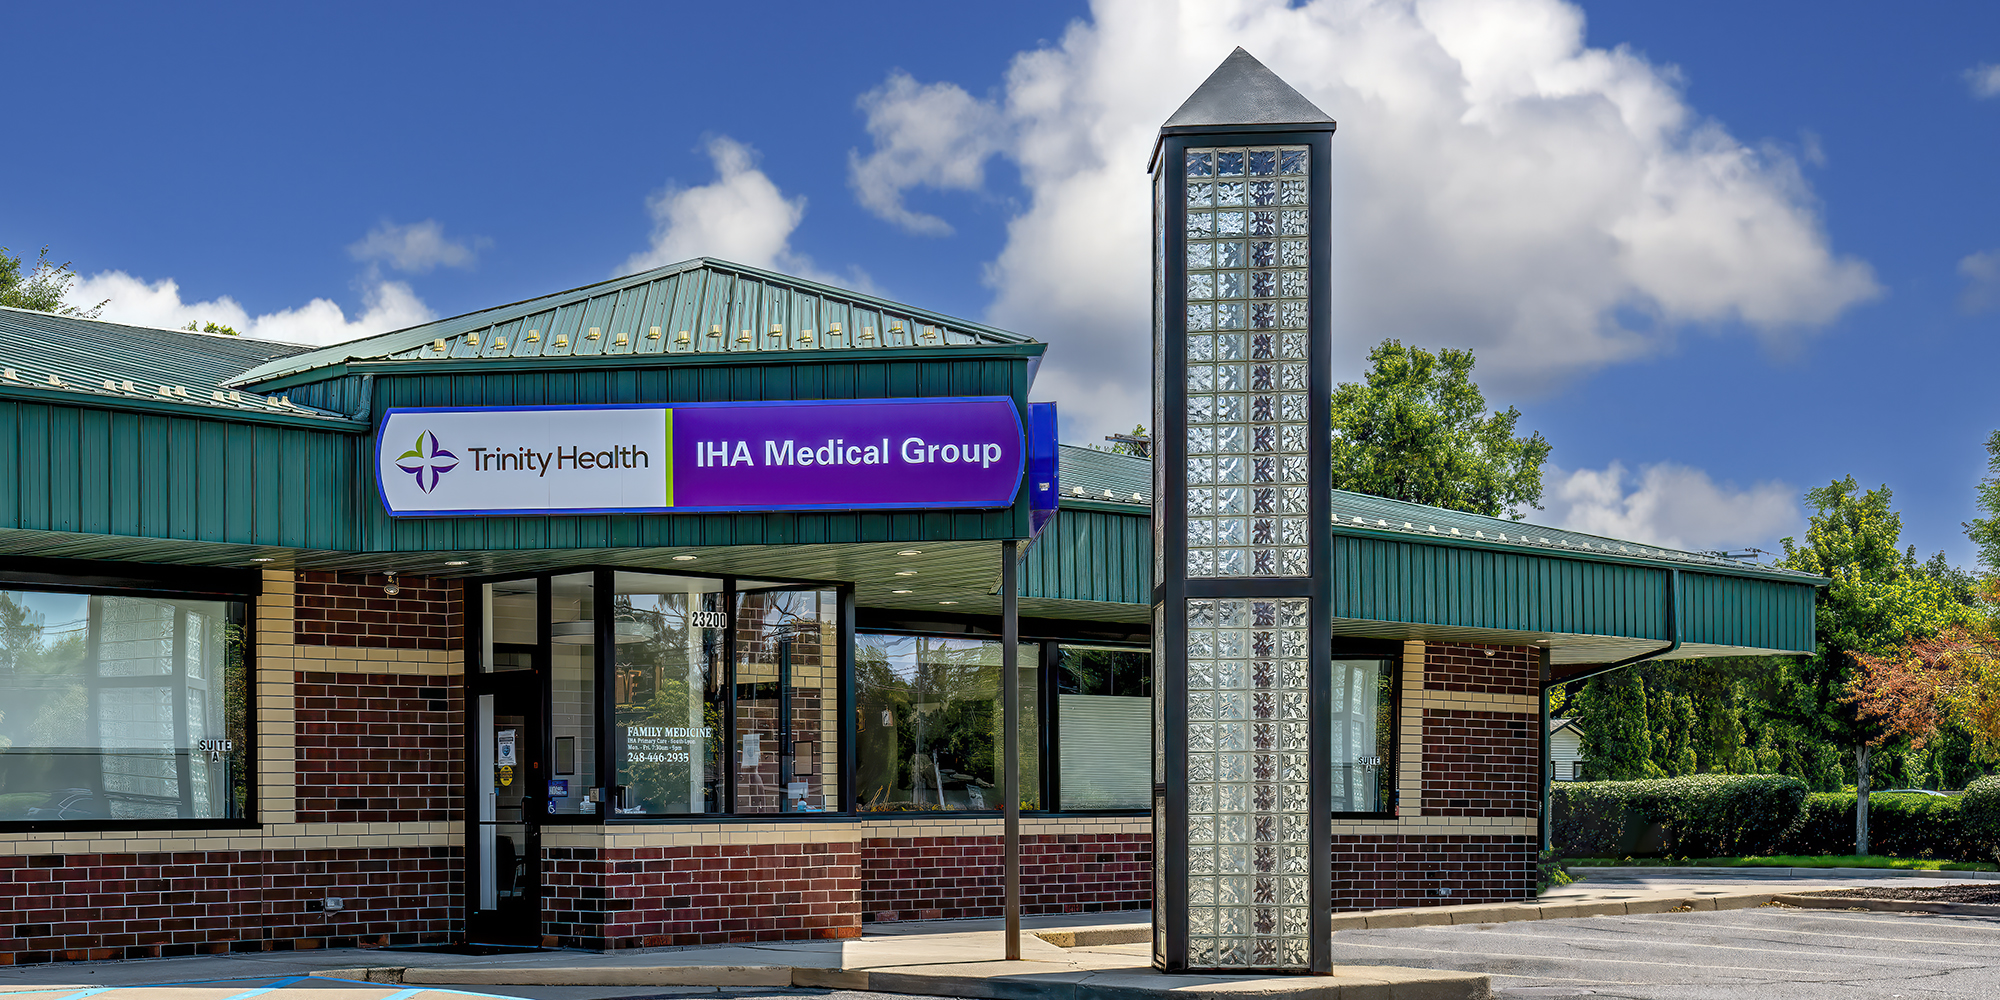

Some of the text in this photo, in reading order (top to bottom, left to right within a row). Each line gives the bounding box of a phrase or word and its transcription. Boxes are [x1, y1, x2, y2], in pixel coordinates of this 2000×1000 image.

[697, 437, 1002, 468] IHA Medical Group
[467, 444, 649, 477] Trinity Health
[692, 611, 726, 627] 23200
[627, 726, 713, 738] FAMILY MEDICINE
[199, 740, 232, 751] SUITE
[212, 751, 219, 762] A
[627, 752, 690, 763] 248-446-2935
[1358, 756, 1380, 765] SUITE
